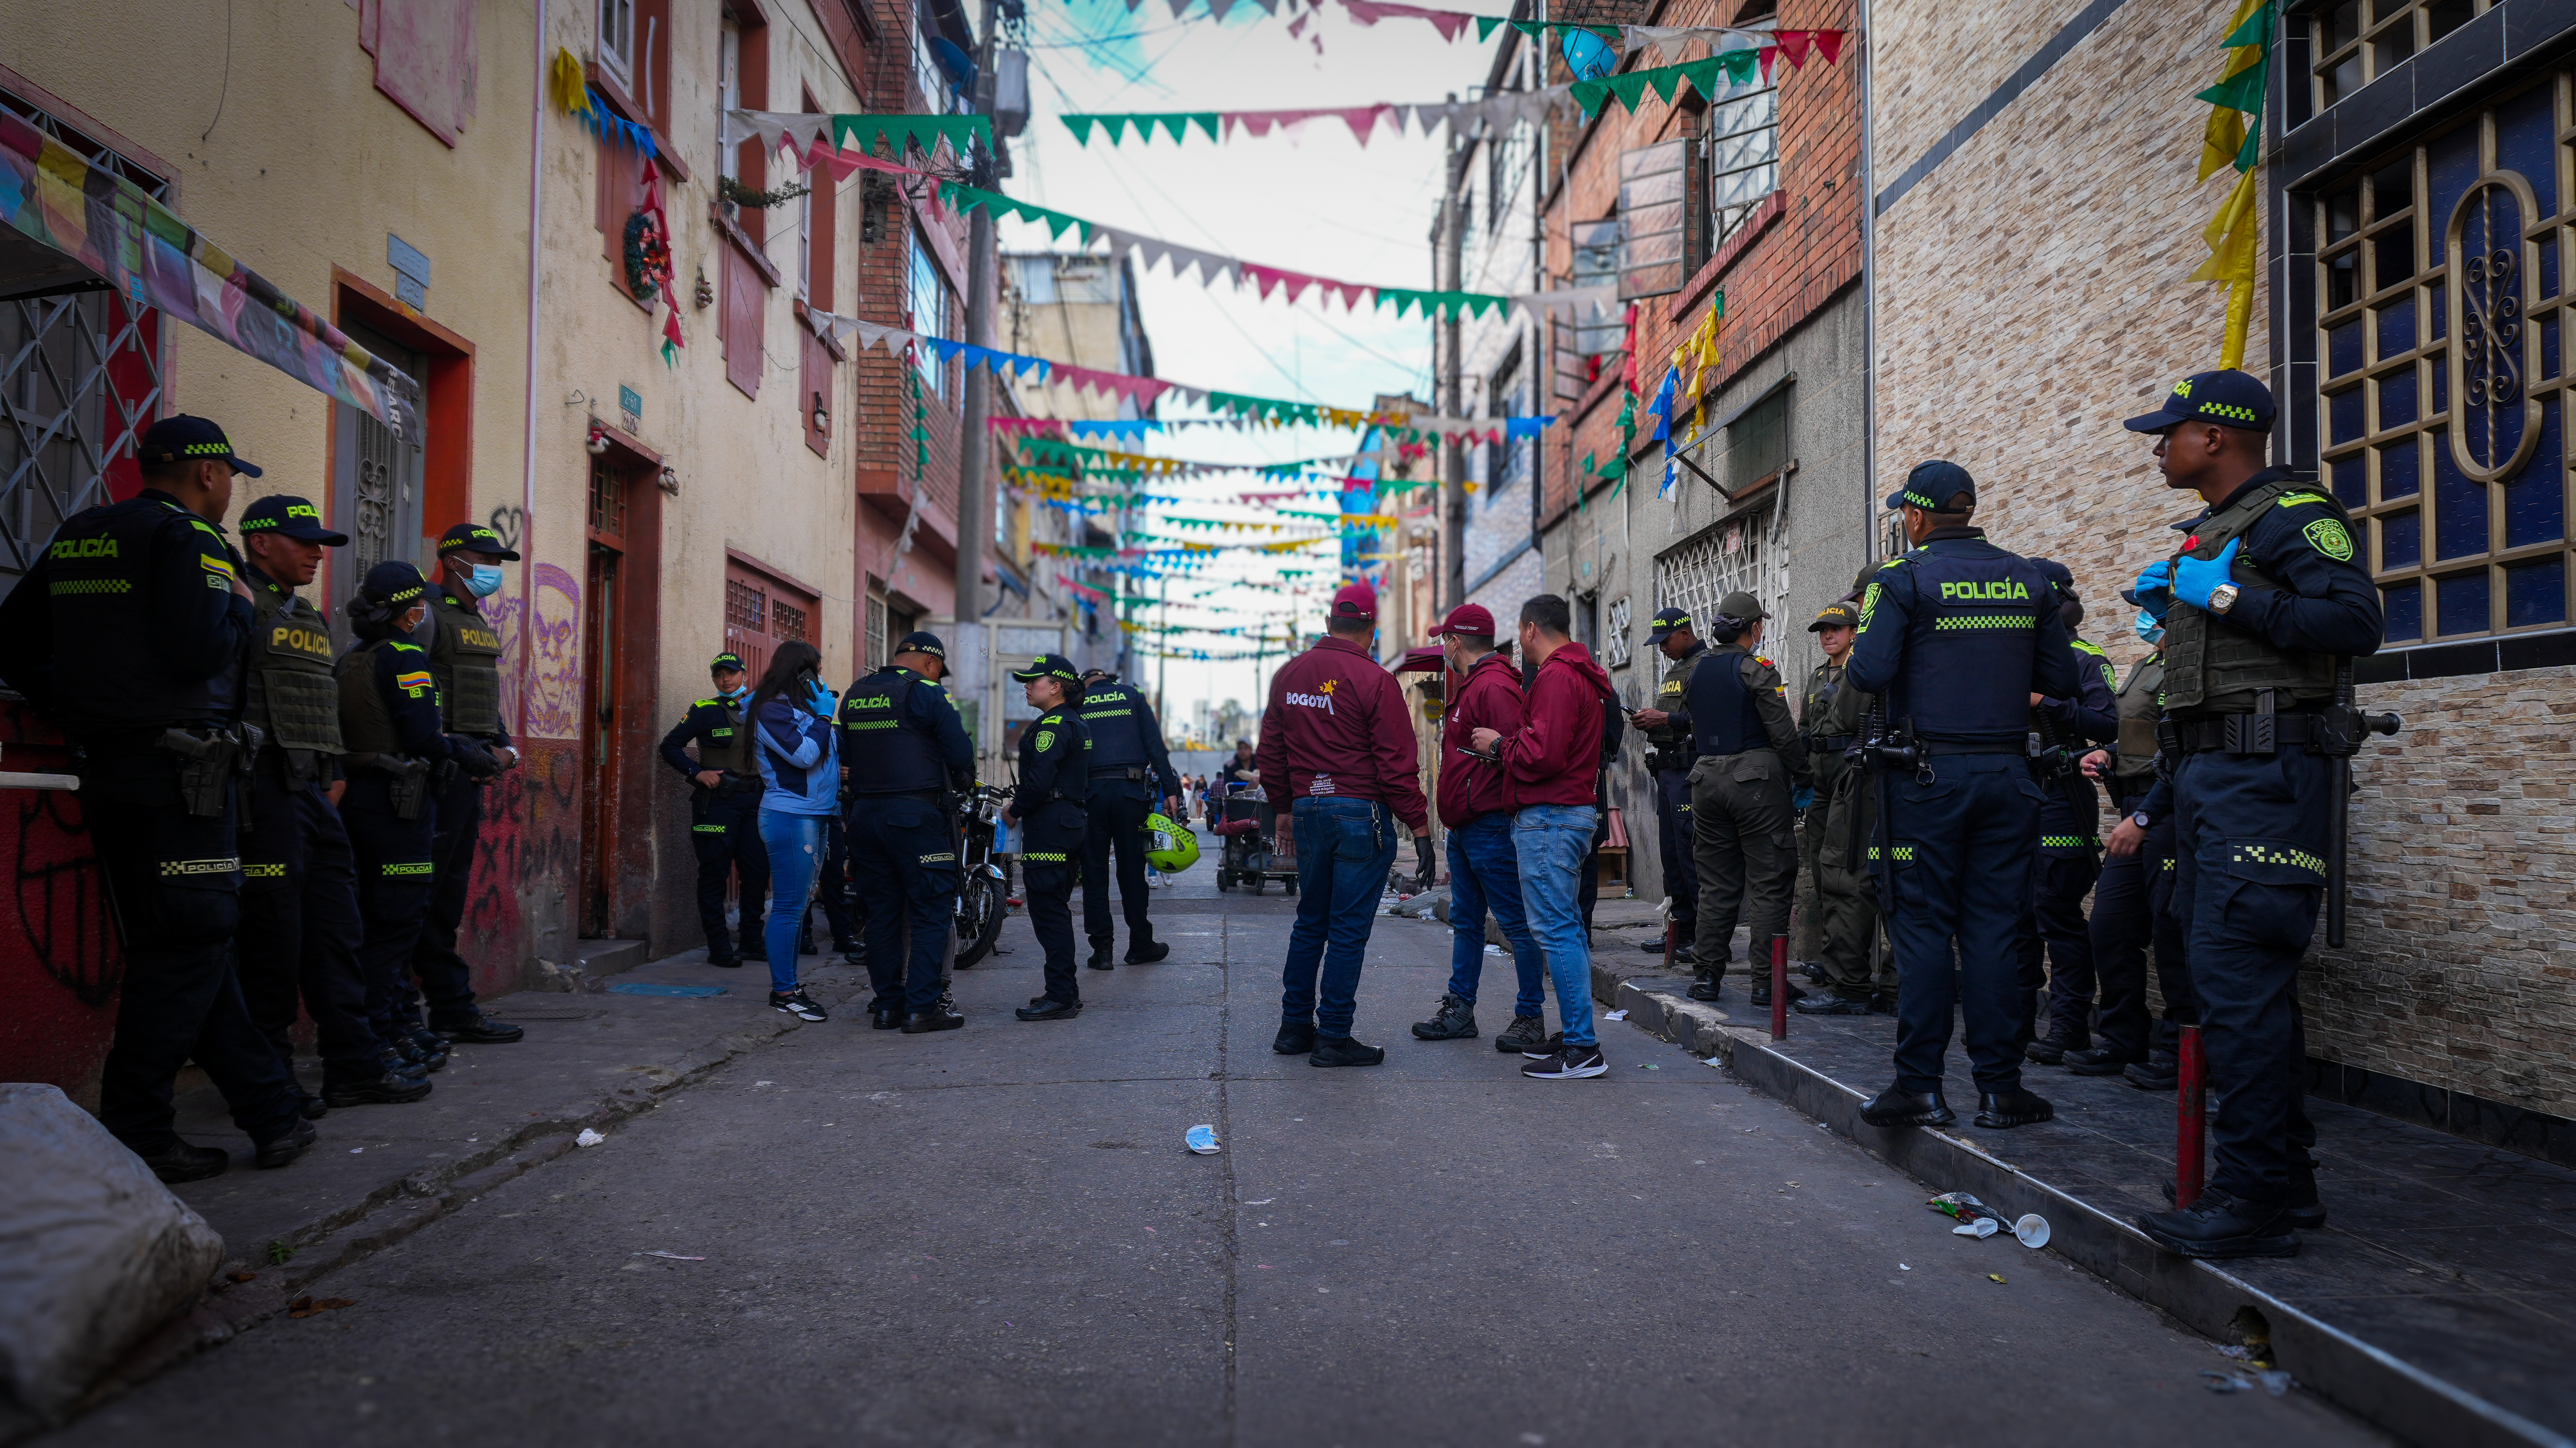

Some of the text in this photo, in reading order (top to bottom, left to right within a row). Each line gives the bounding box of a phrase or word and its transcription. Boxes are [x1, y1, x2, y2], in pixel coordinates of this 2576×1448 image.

[624, 391, 637, 411] 2-61
[2310, 521, 2338, 531] POLICÍA
[2311, 526, 2346, 540] NACIONAL
[49, 532, 119, 560] POLICÍA
[1940, 576, 2030, 600] POLICÍA
[272, 627, 332, 658] POLICIA
[460, 628, 500, 649] POLICIA
[847, 694, 890, 710] POLICÍA
[1083, 691, 1127, 705] POLICÍA
[188, 862, 233, 872] POLICÍA
